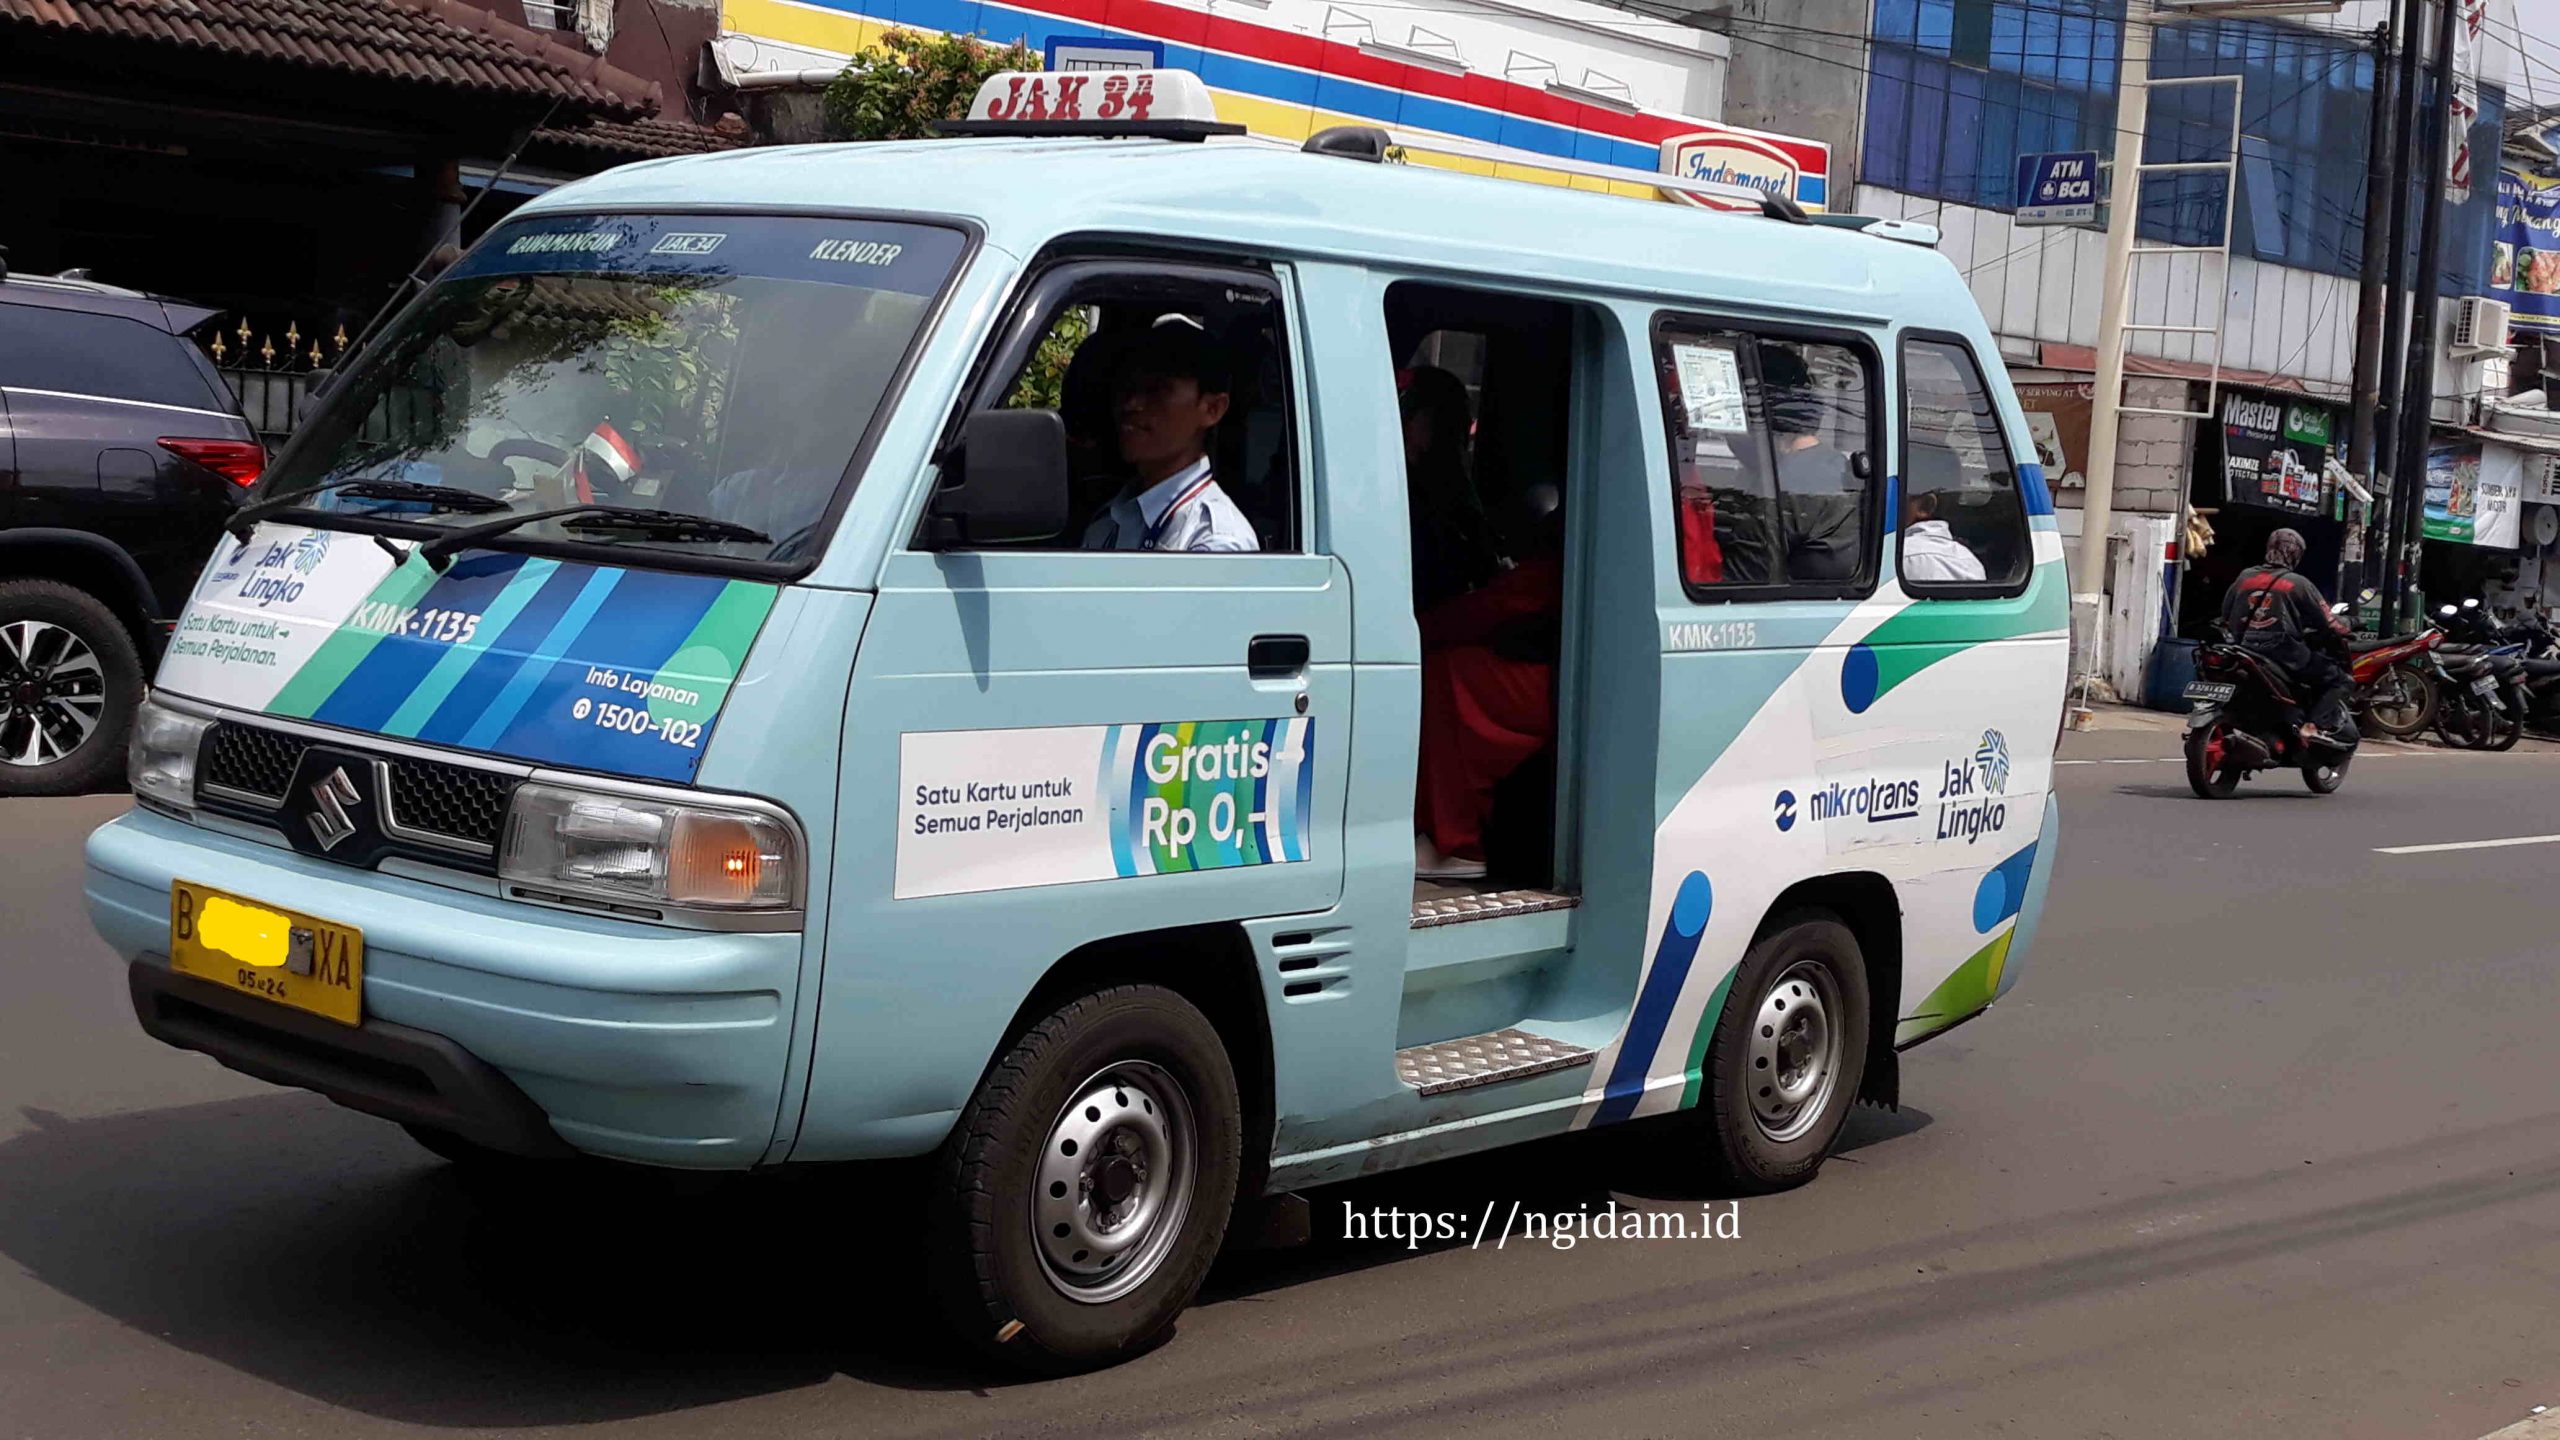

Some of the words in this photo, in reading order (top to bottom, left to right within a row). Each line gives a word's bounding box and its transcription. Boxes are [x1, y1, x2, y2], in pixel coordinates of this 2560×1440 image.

[988, 76, 1089, 120] JAK
[1097, 74, 1154, 120] 34
[1689, 152, 1787, 197] Indomaret
[2049, 160, 2084, 178] ATM
[2058, 180, 2090, 198] BCA
[506, 232, 623, 255] RAWAMANGUN
[809, 238, 903, 266] KLENDER
[2026, 388, 2061, 397] SERVING
[2063, 389, 2076, 397] AT
[2224, 392, 2281, 432] Master
[254, 541, 290, 569] Jak
[237, 570, 305, 608] Lingko
[183, 612, 206, 631] Satu
[207, 614, 238, 635] Kartu
[239, 618, 278, 640] untuk
[172, 636, 204, 656] Semua
[208, 639, 277, 666] Perjalanan.
[585, 666, 619, 688] Info
[620, 674, 699, 706] Layanan
[595, 702, 702, 748] 1500-102
[1144, 729, 1270, 784] Gratis
[914, 783, 960, 806] Satu
[966, 781, 1017, 803] Kartu
[1022, 777, 1073, 799] untuk
[1938, 759, 1975, 799] Jak
[1810, 777, 1920, 823] mikrotrans
[914, 811, 981, 835] Semua
[986, 806, 1084, 834] Perjalanan
[1142, 797, 1197, 859] Rp
[1936, 799, 2005, 845] Lingko
[177, 888, 194, 940] B
